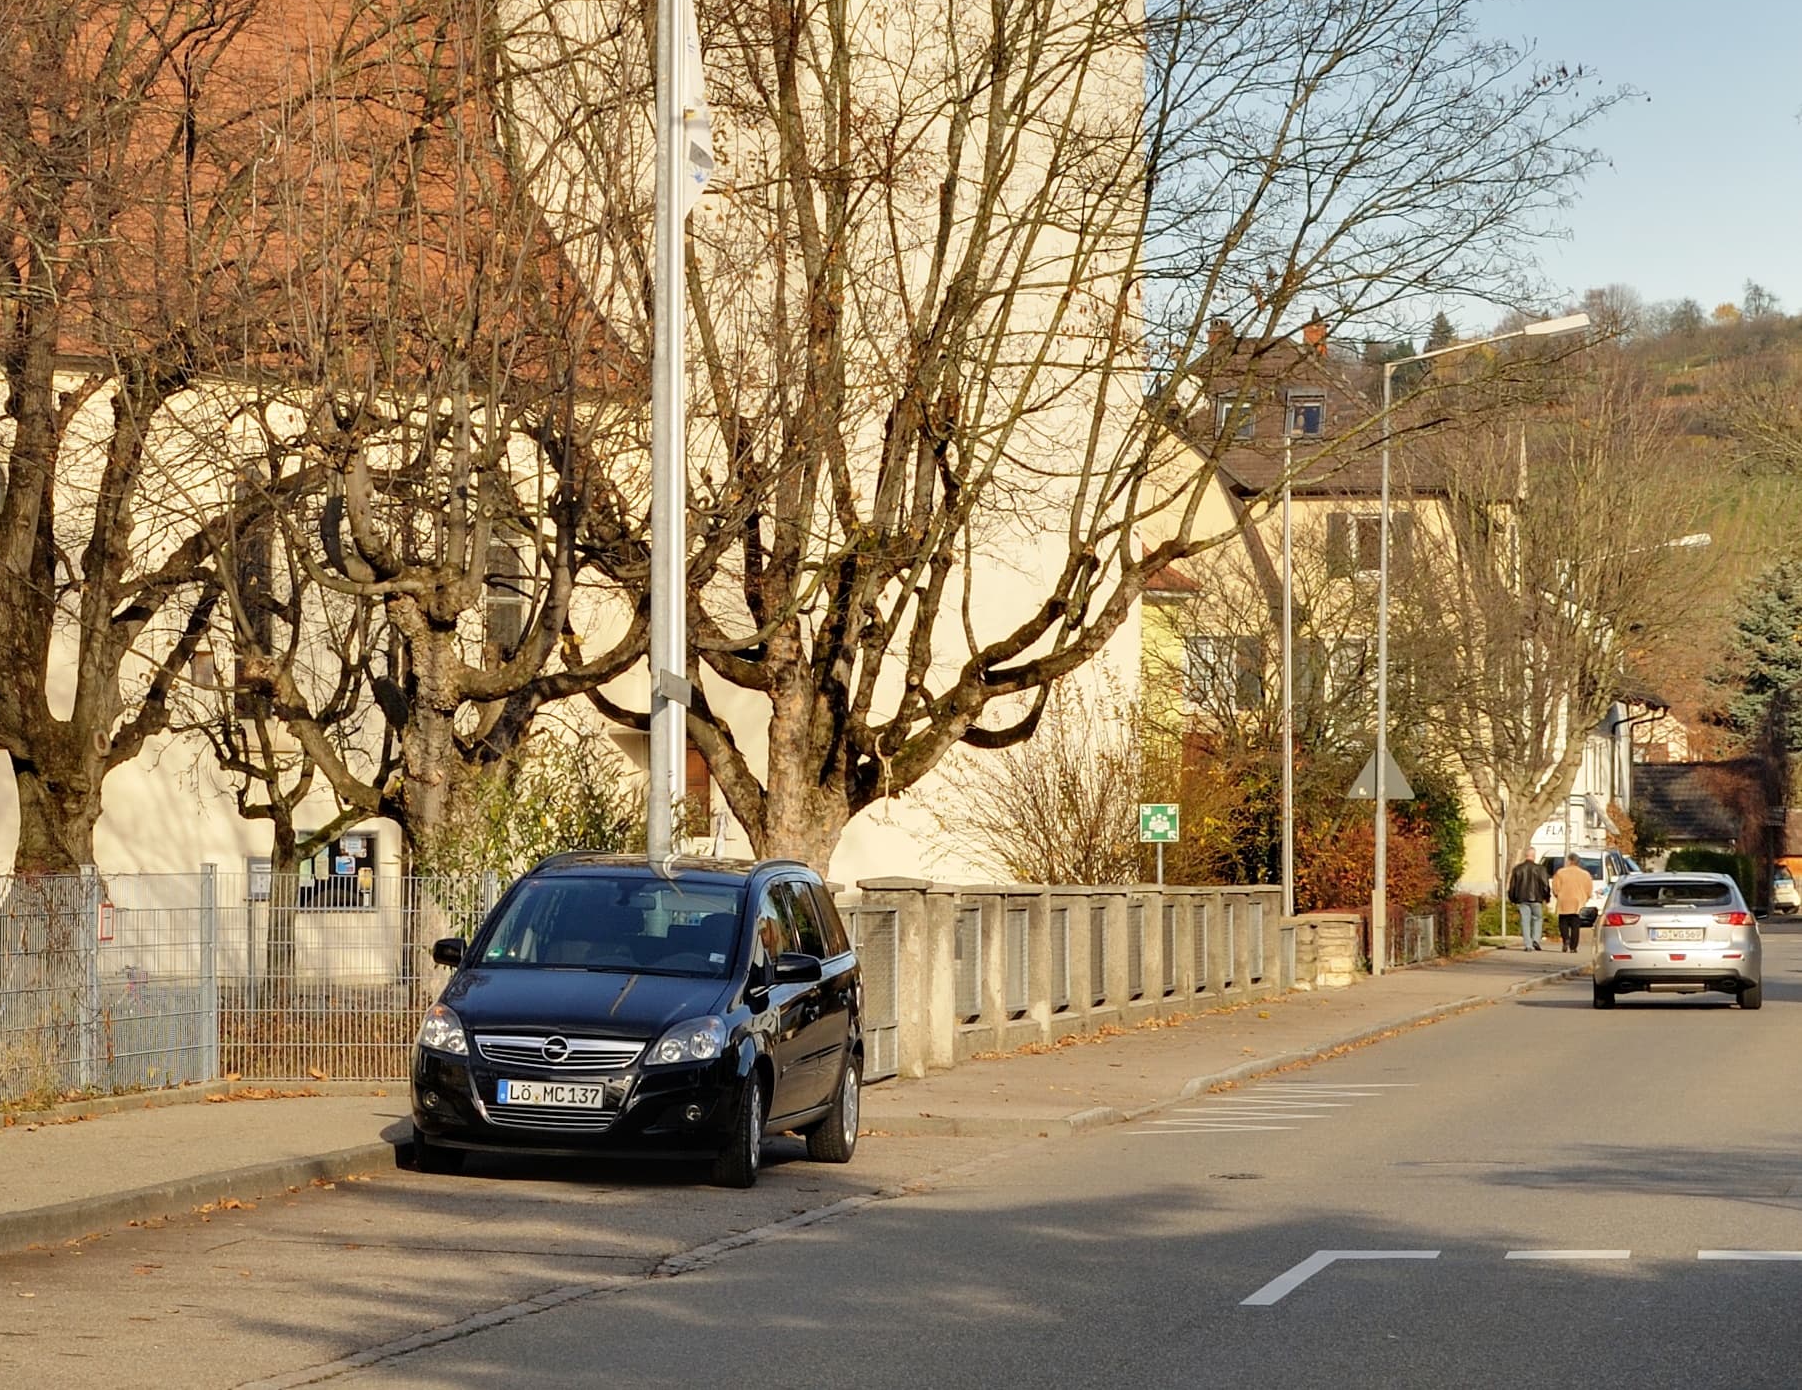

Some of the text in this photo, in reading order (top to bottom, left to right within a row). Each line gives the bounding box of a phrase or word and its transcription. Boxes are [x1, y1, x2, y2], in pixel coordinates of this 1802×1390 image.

[510, 1083, 600, 1105] LÖ MC 137
